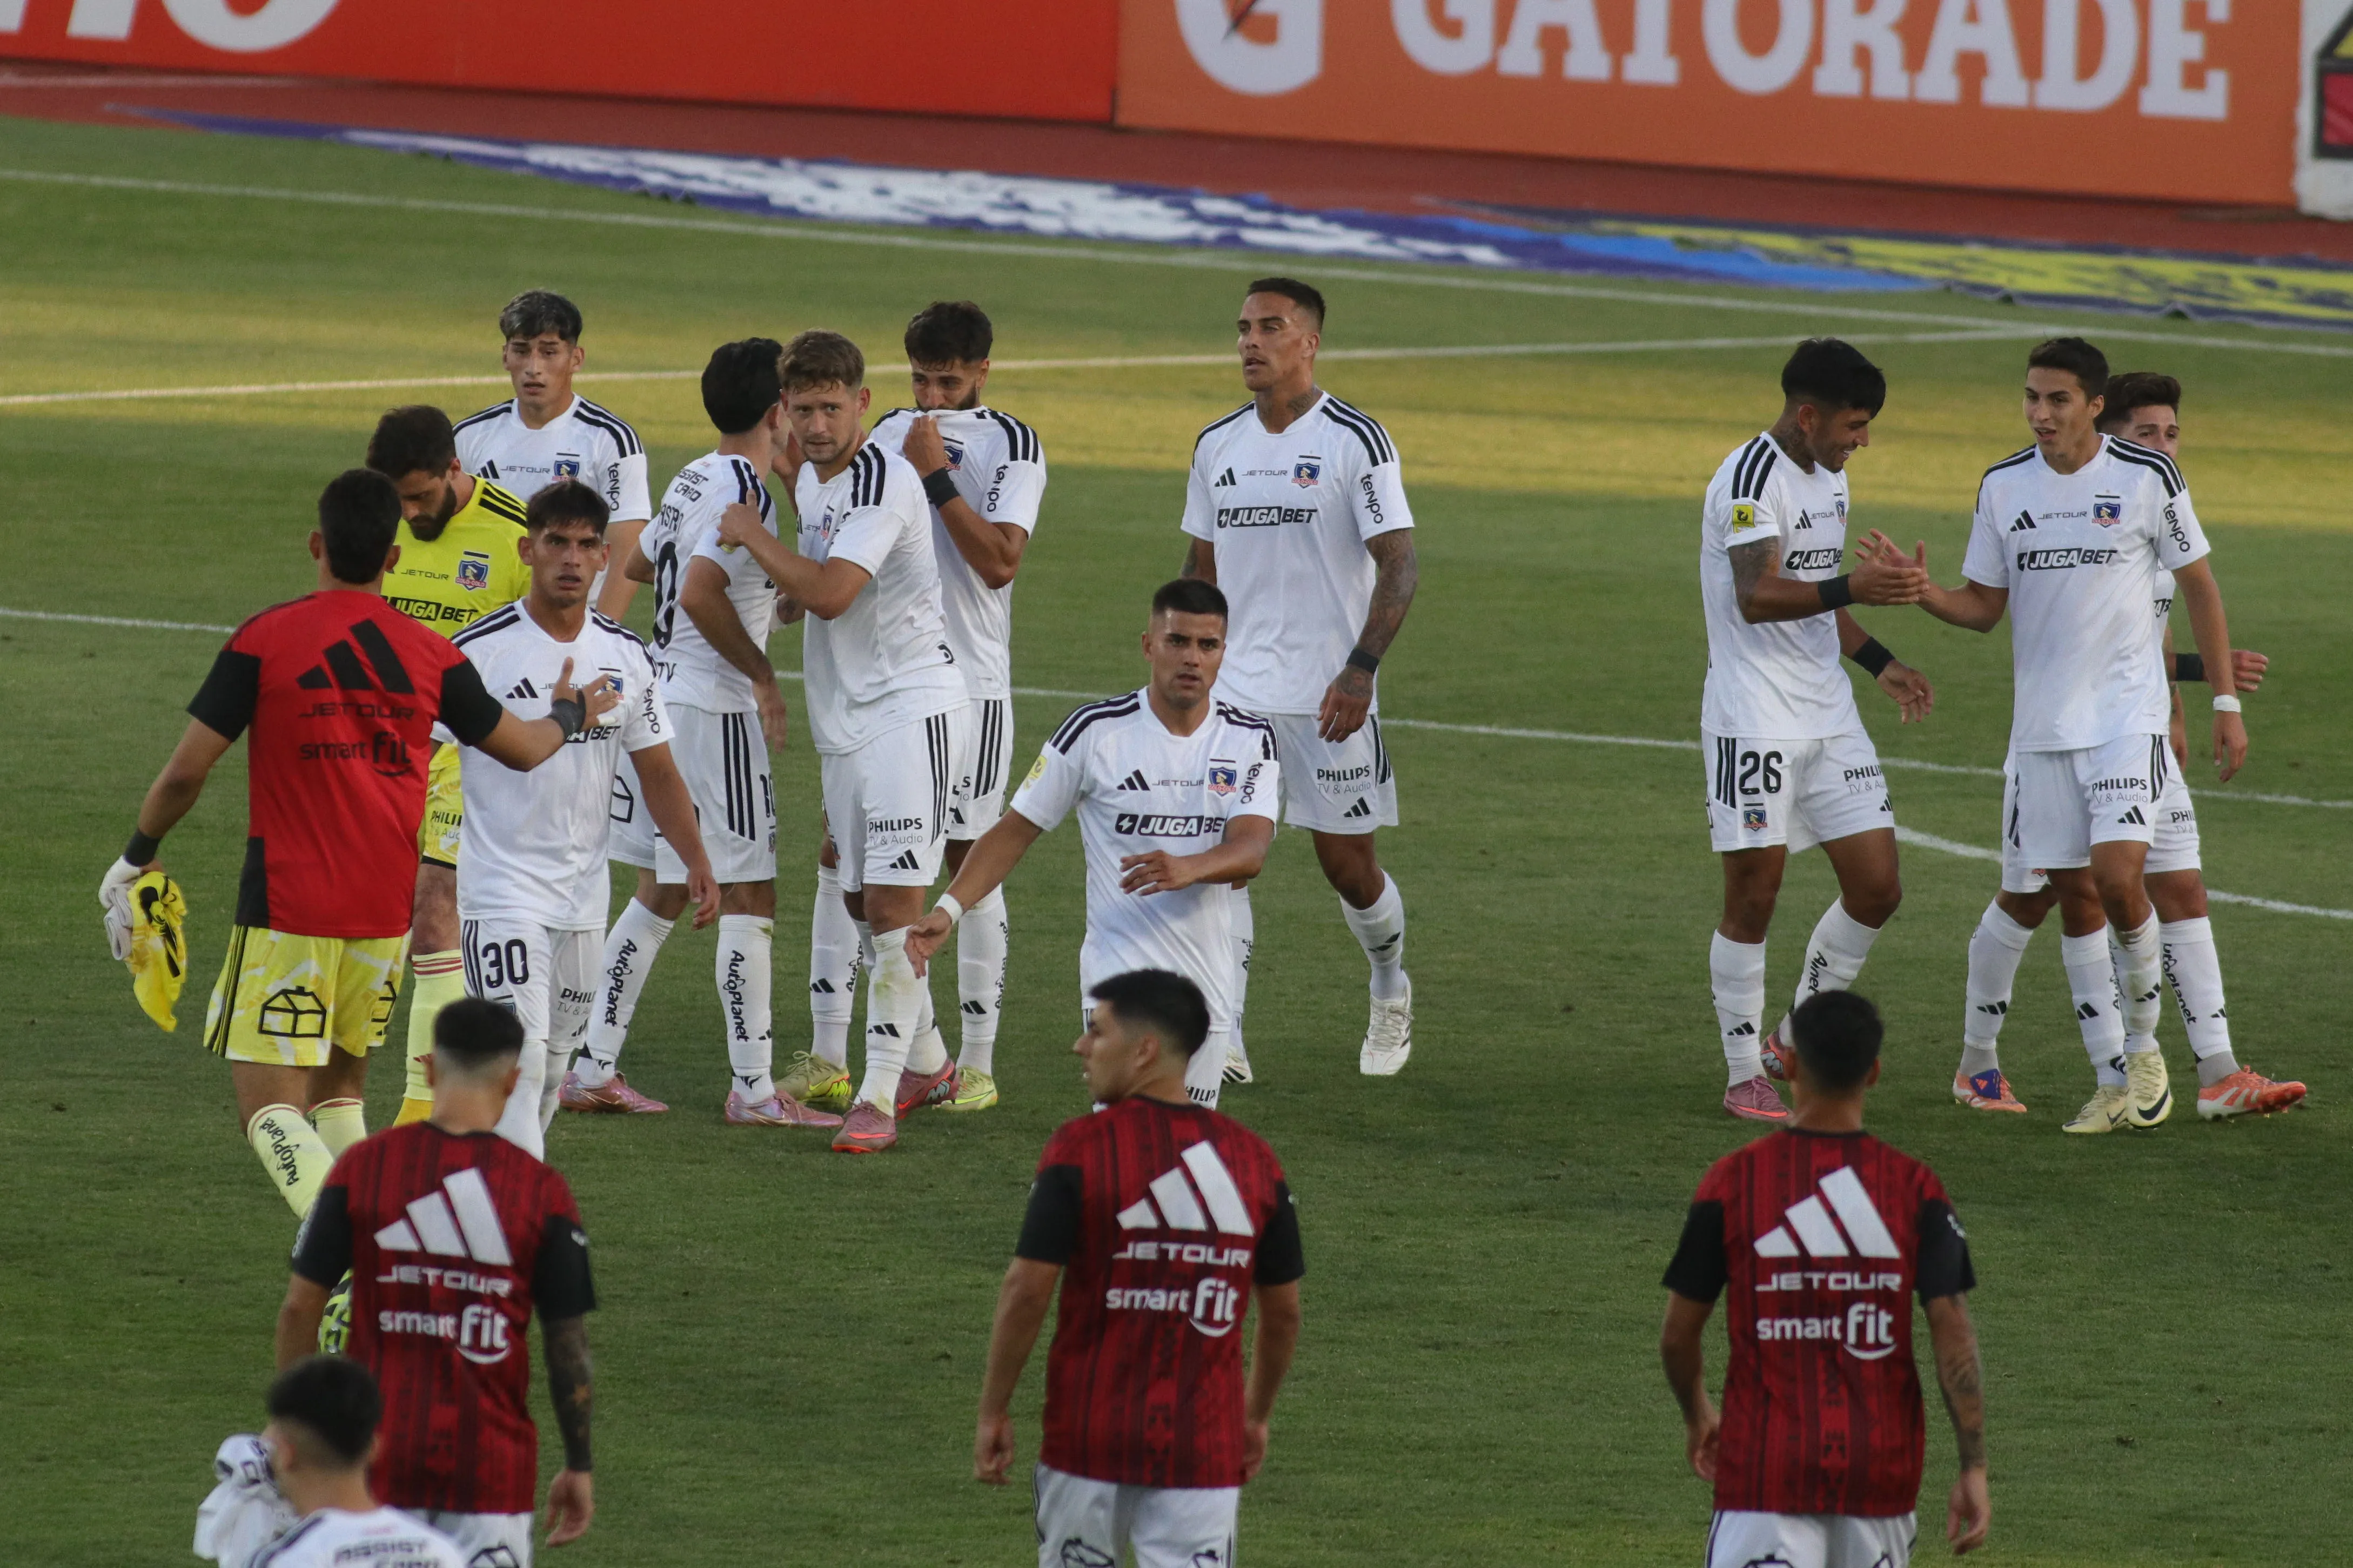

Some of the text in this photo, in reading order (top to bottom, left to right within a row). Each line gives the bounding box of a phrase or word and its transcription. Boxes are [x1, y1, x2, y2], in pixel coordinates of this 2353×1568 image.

[1389, 0, 2229, 119] GATORADE
[500, 465, 551, 474] JETOUR
[678, 468, 709, 486] SSIST
[1230, 506, 1318, 528] JUGABET
[2037, 510, 2088, 520] JETOUR
[2027, 548, 2117, 570] JUGABET
[400, 569, 450, 581] JETOUR
[298, 703, 415, 721] JETOUR
[299, 731, 412, 764] smart fit
[1317, 765, 1370, 782] PHILIPS
[1739, 751, 1783, 795] 26
[1843, 765, 1881, 782] PHILI
[1317, 781, 1371, 794] TV & Audio
[1848, 782, 1861, 794] TV
[1865, 781, 1872, 791] &
[2092, 778, 2147, 796] PHILIPS
[2106, 793, 2113, 803] &
[2116, 792, 2148, 803] Audio
[868, 817, 922, 833] PHILIPS
[1137, 815, 1228, 837] JUGABE
[880, 835, 888, 845] &
[890, 832, 923, 844] Audio
[481, 938, 529, 988] 30
[558, 1000, 572, 1013] TV
[1111, 1241, 1251, 1268] JETOUR
[375, 1264, 513, 1296] JETOUR
[1755, 1272, 1902, 1291] JETOUR
[1105, 1277, 1239, 1322] smart fit
[378, 1303, 510, 1349] smart fit
[1757, 1302, 1894, 1344] smart fit
